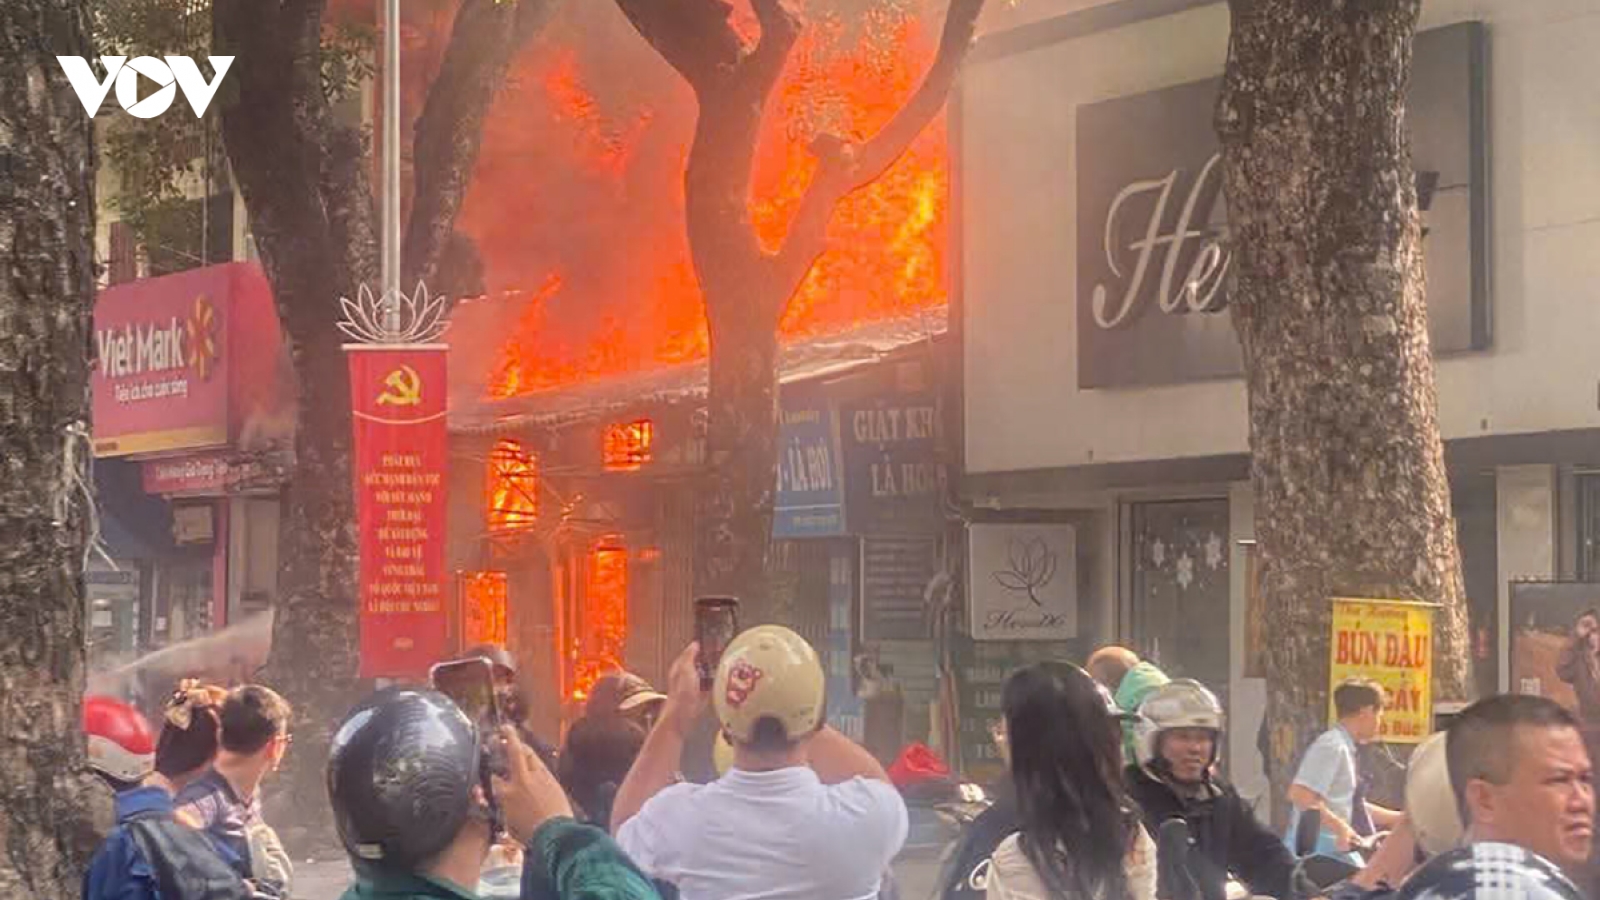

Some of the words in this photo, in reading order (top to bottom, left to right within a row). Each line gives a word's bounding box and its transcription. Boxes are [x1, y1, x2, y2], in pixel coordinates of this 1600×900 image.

[1093, 153, 1232, 328] He
[135, 317, 185, 373] Mark
[871, 453, 897, 496] LÀ
[1336, 621, 1378, 665] BÚN
